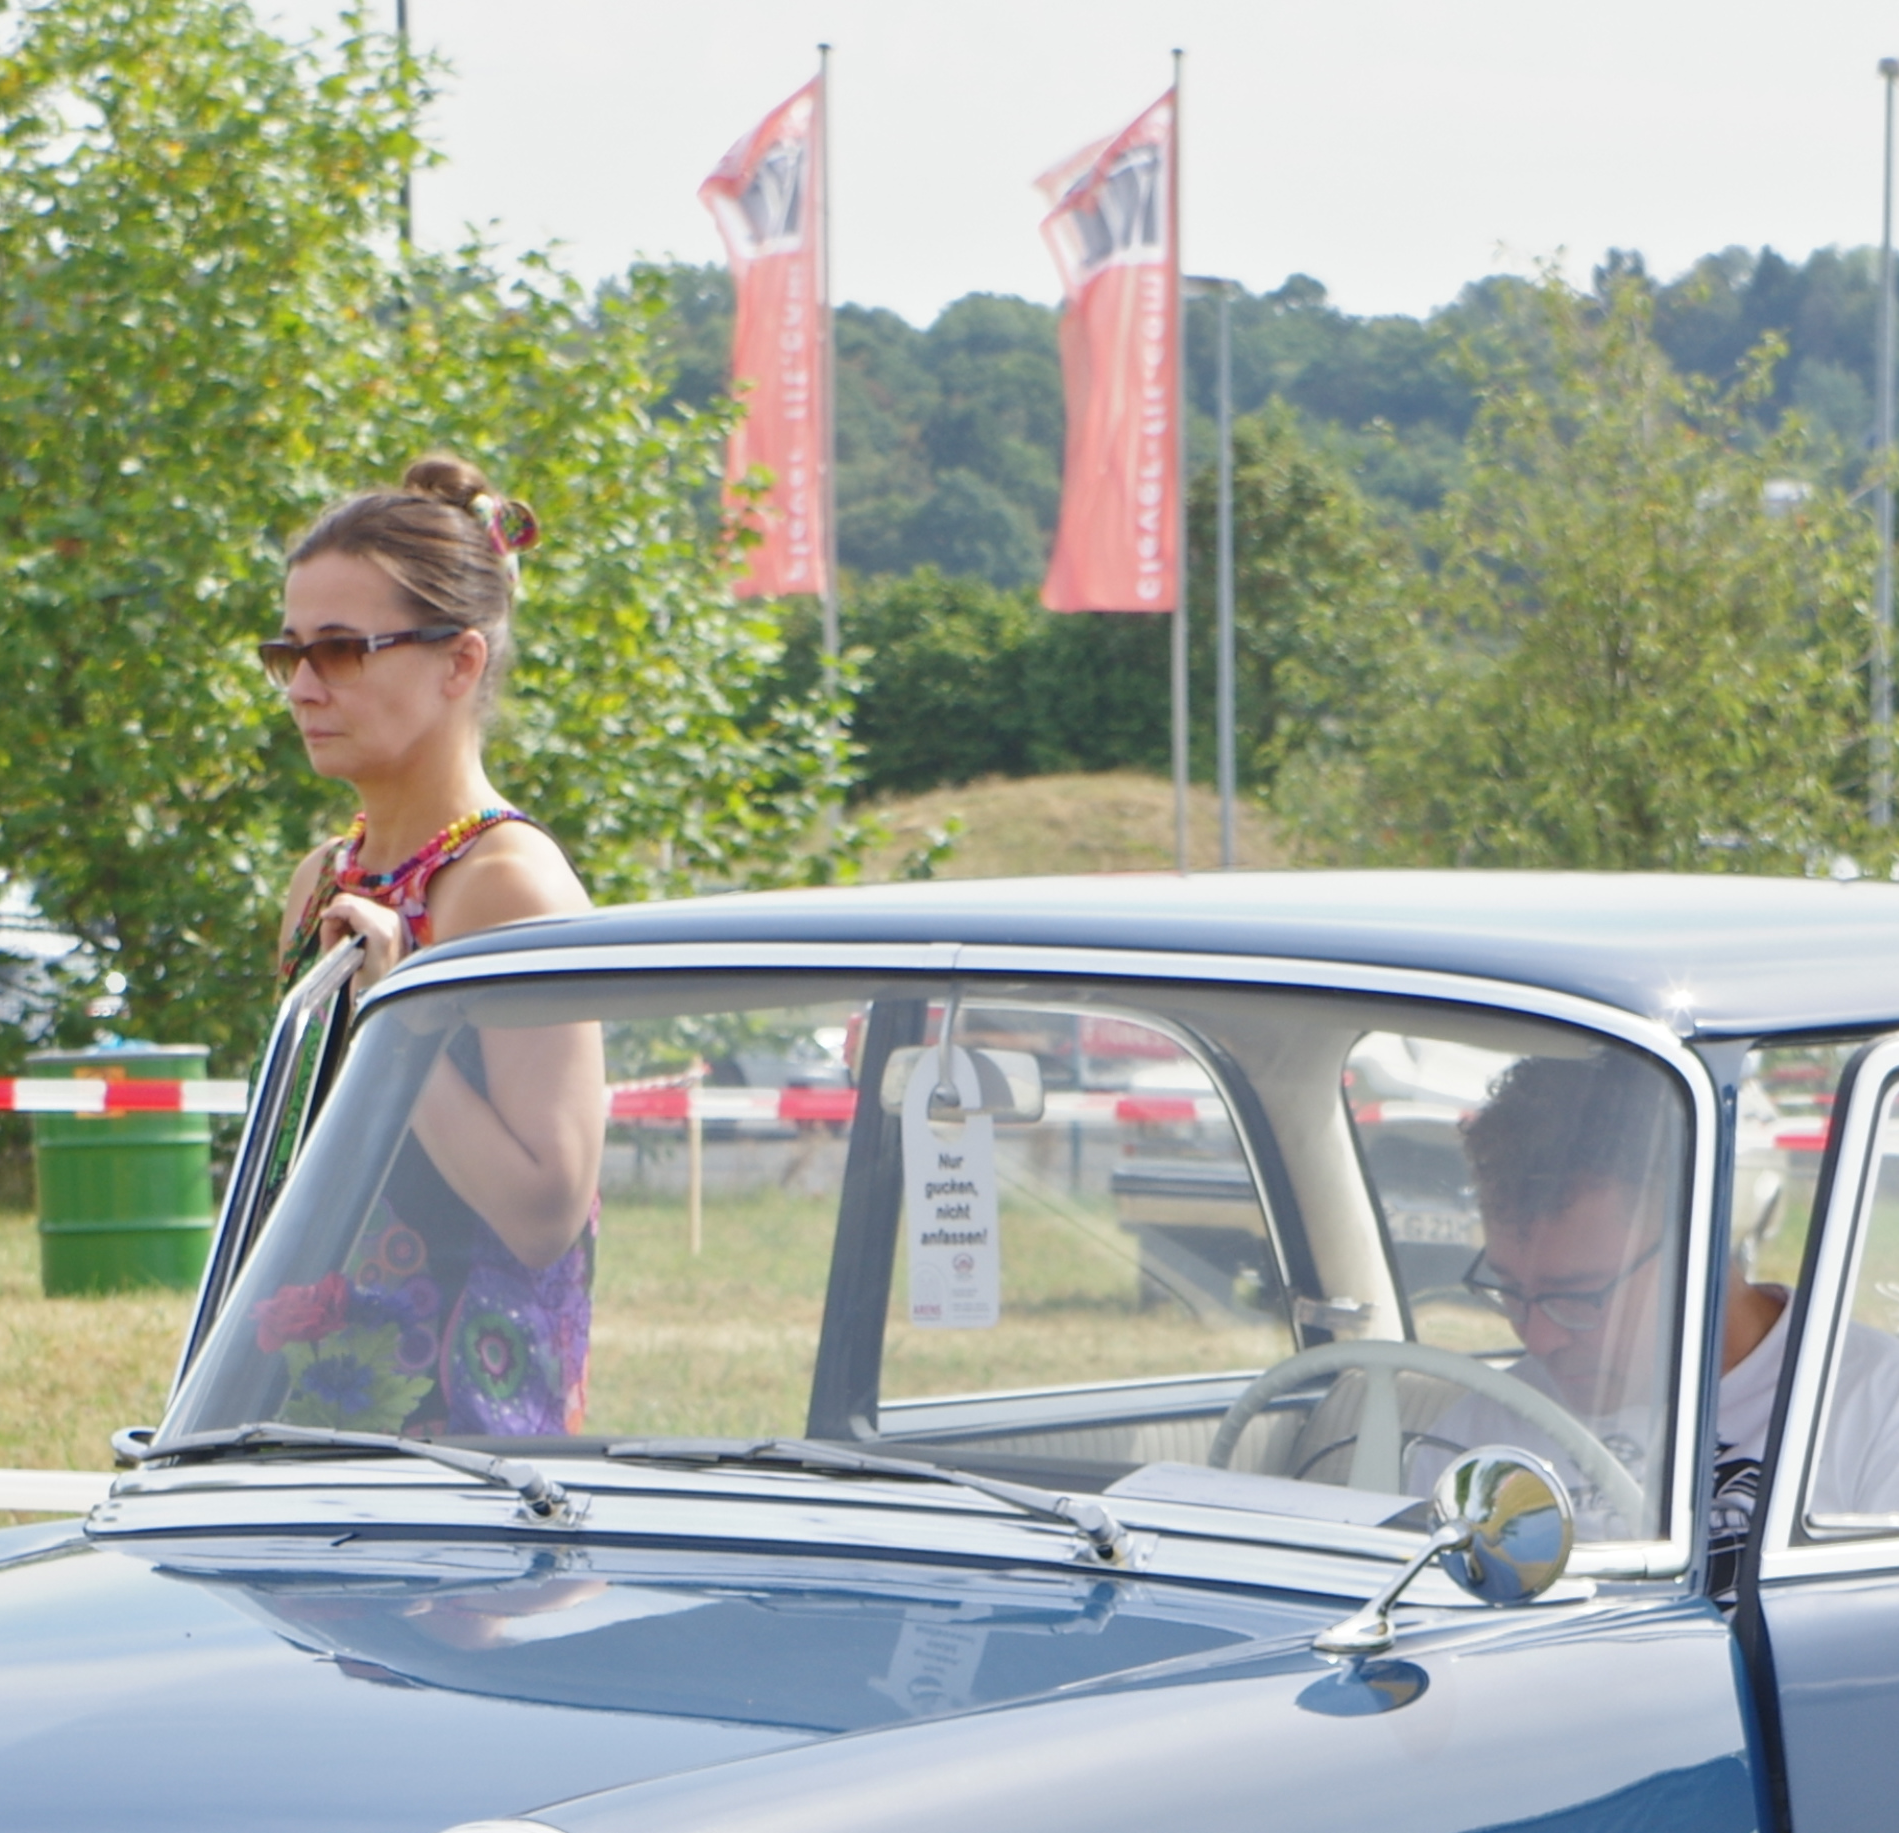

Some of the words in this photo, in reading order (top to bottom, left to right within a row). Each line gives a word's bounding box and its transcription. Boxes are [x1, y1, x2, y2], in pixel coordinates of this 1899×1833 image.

[938, 1154, 964, 1169] Nur
[925, 1179, 978, 1199] gucken,
[936, 1204, 970, 1220] nicht
[921, 1229, 987, 1245] anfassen!
